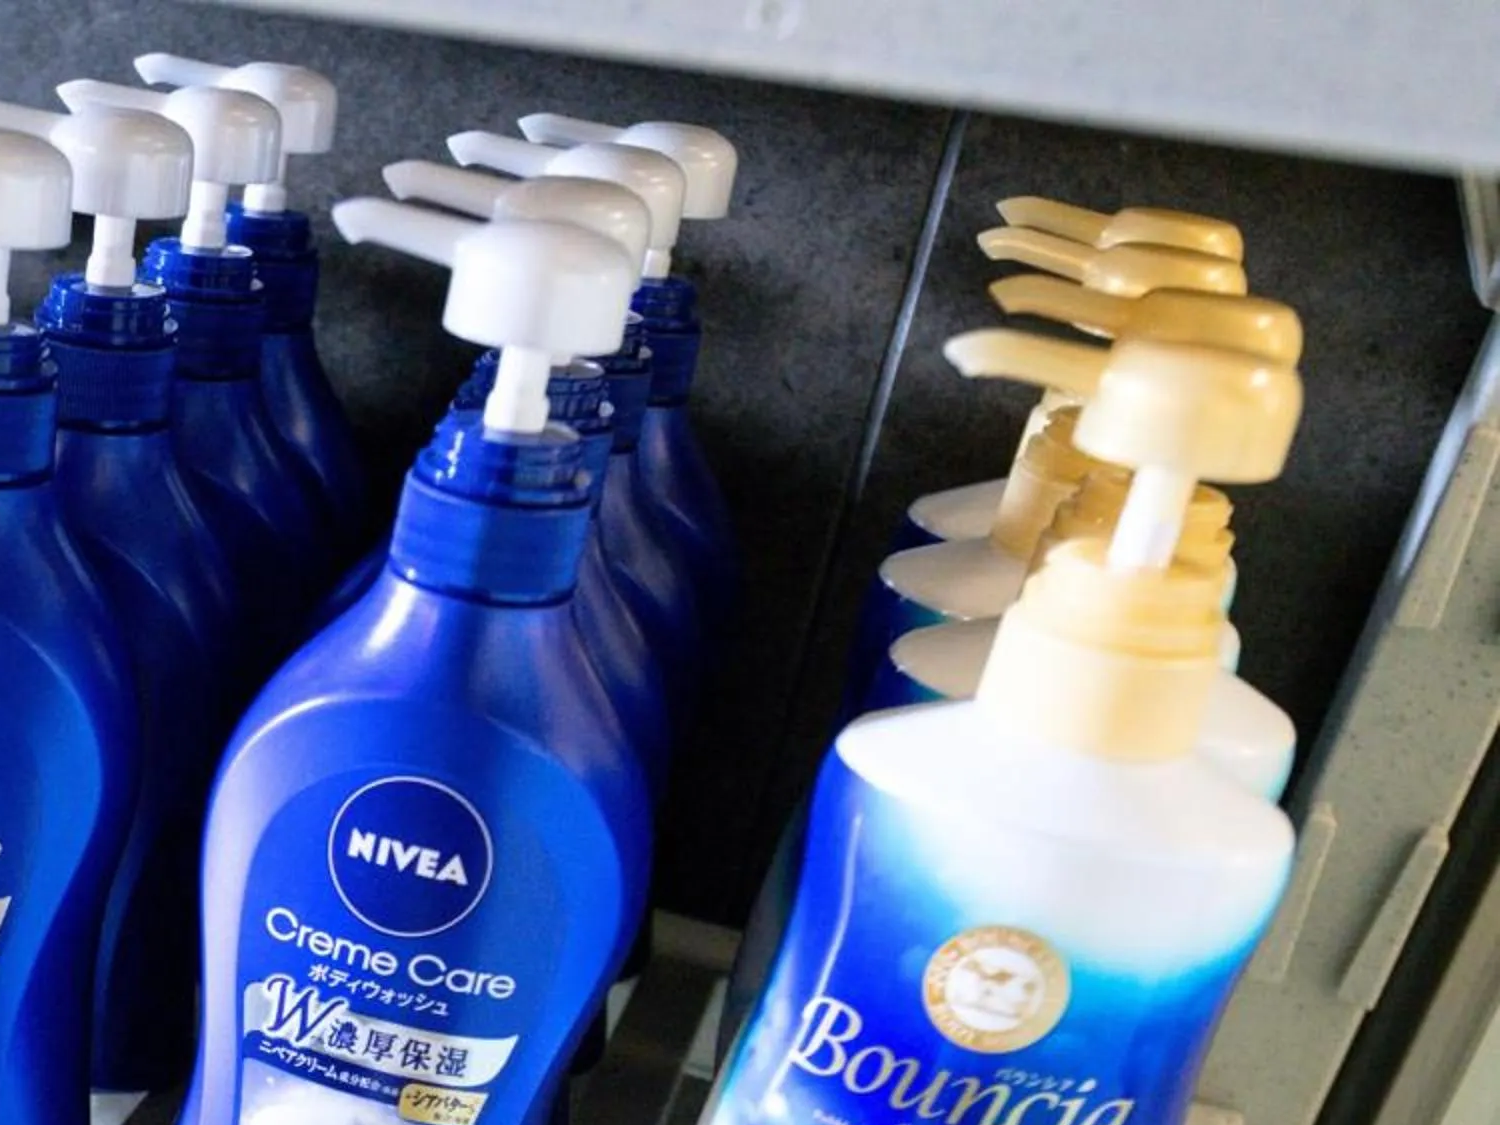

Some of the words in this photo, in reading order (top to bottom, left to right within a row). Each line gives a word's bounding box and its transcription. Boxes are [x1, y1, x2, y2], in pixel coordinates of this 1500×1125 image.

[347, 826, 469, 887] NIVEA
[265, 906, 399, 977] Creme
[408, 953, 517, 1000] Care
